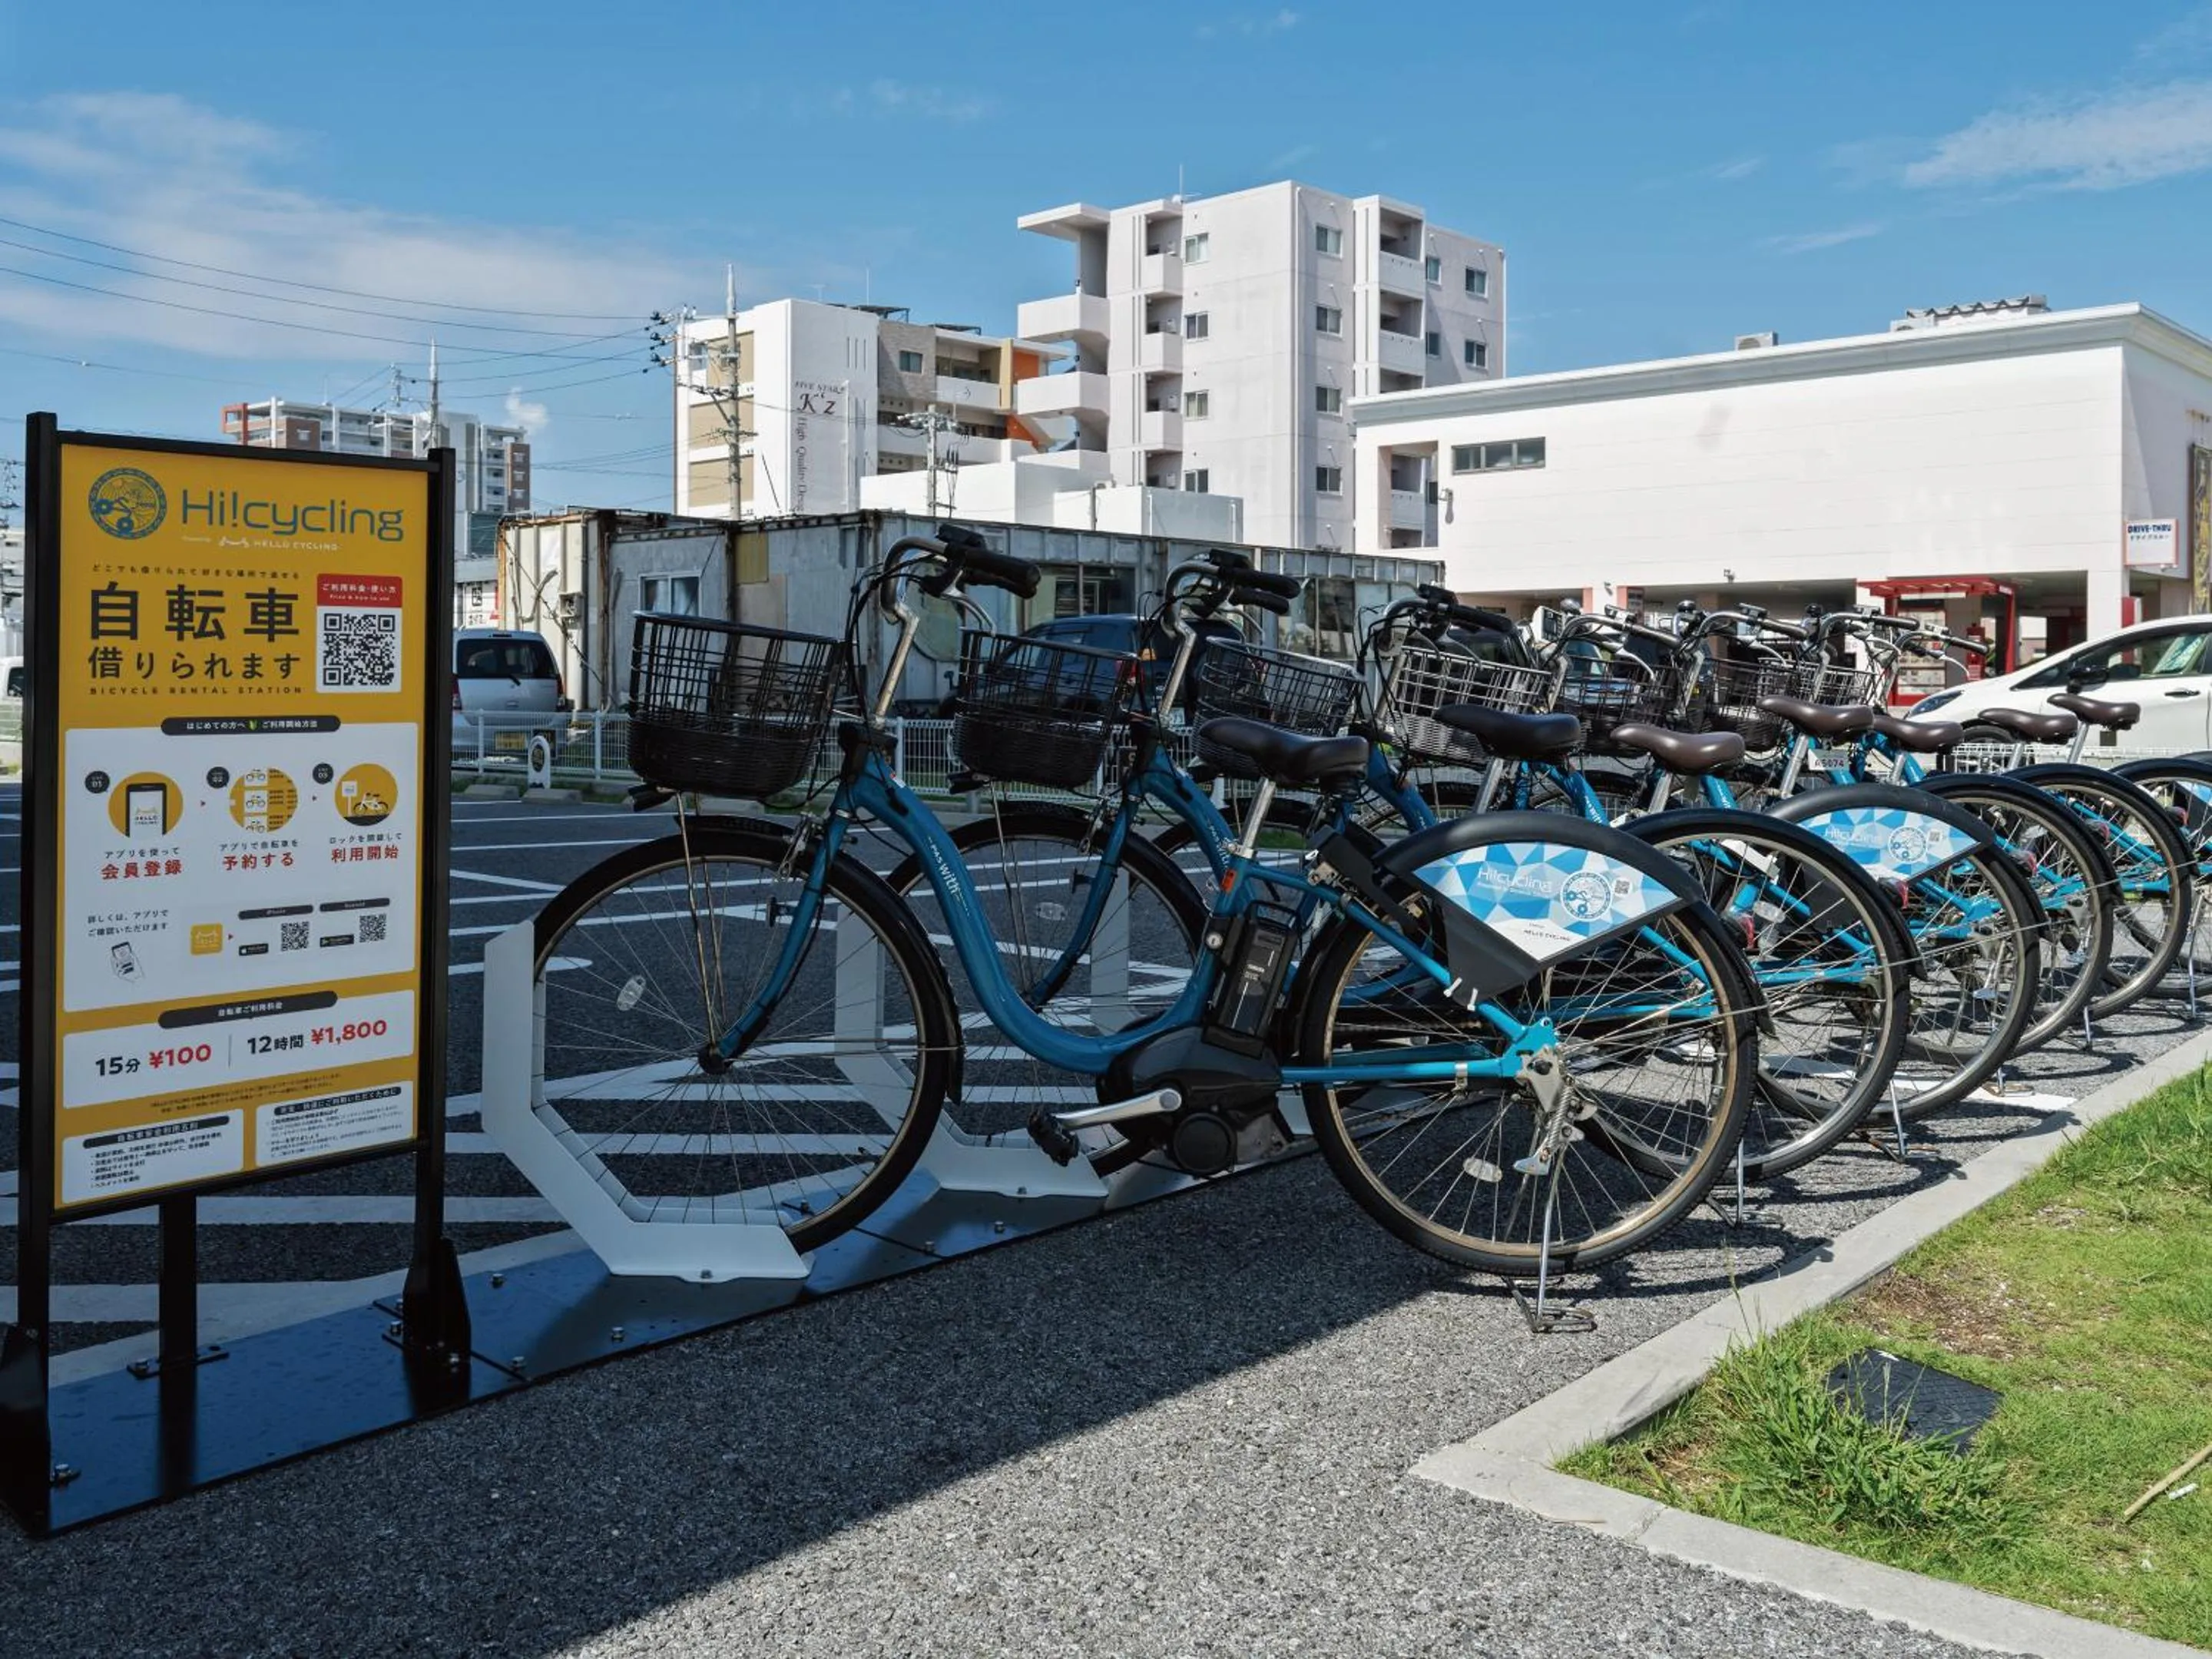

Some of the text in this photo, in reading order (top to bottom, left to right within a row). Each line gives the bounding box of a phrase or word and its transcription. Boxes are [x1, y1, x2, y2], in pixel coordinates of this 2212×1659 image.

[182, 488, 404, 541] Hi!cycling
[253, 540, 339, 551] HELLO CYCLING
[91, 581, 300, 642] 自転車
[88, 647, 300, 679] 借りられます
[187, 721, 246, 730] はじめての方へ
[104, 847, 180, 859] アプリを使って
[223, 852, 294, 871] 予約する
[331, 845, 399, 863] 利用開始
[101, 859, 182, 880] 会員登録
[247, 1020, 387, 1055] 12時間 ¥1,800
[96, 1044, 211, 1076] 15分 ¥100
